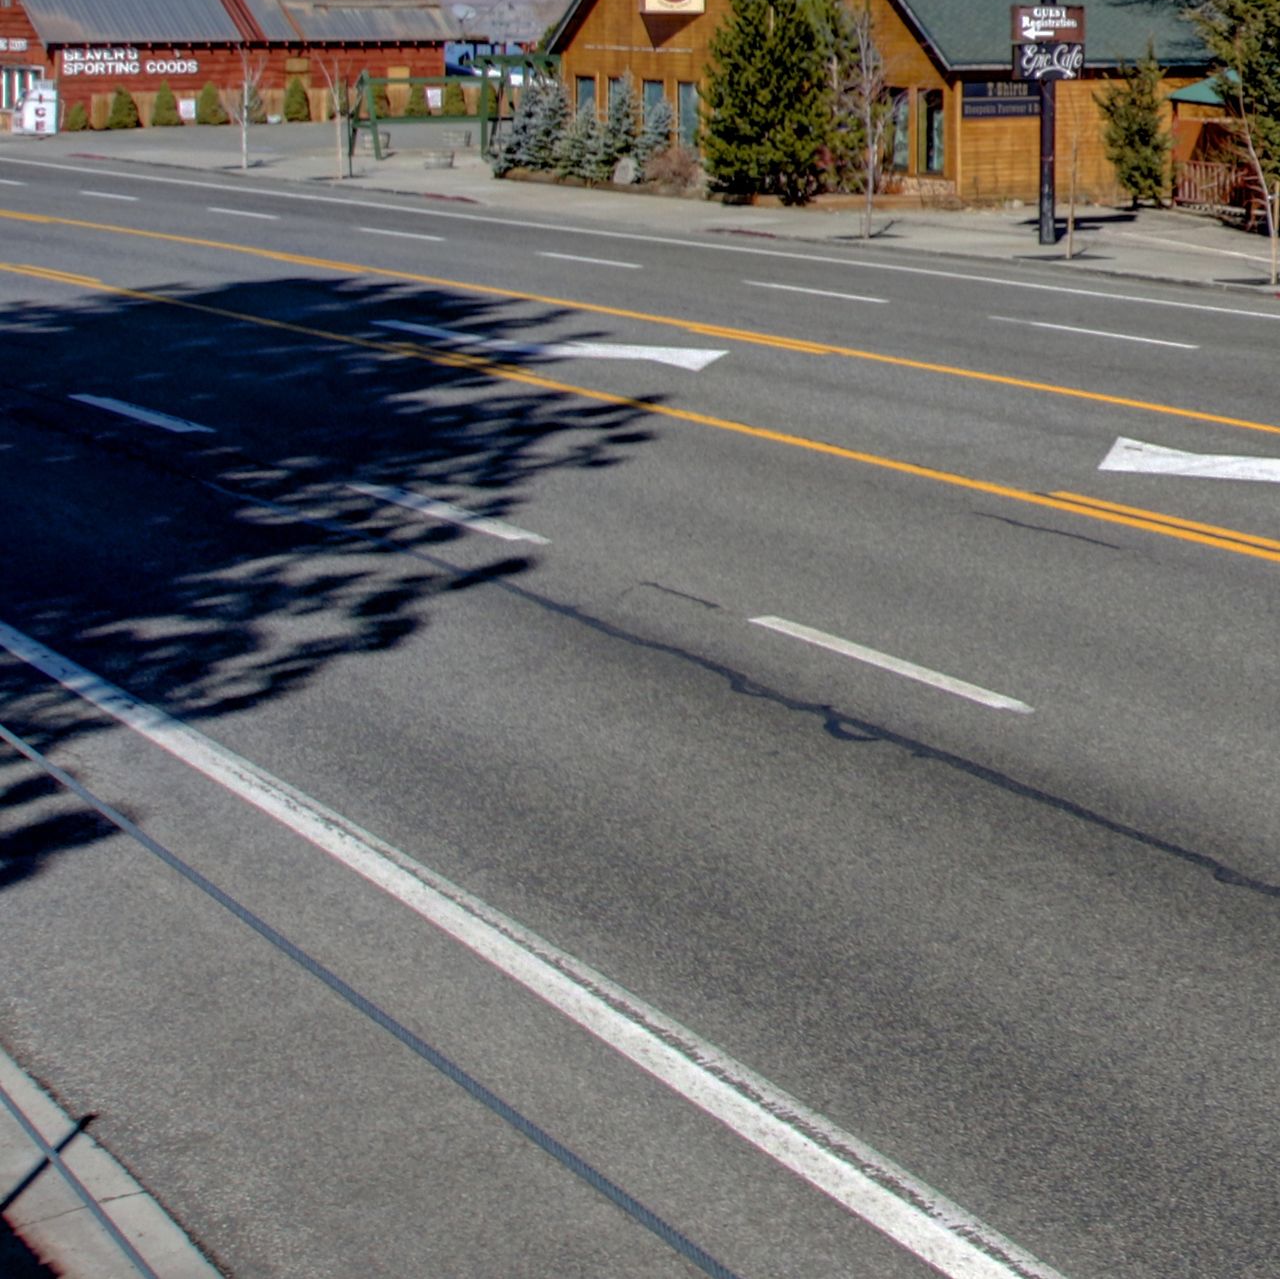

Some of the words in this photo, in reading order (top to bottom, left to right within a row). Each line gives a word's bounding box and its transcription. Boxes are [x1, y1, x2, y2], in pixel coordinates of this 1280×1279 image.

[63, 61, 140, 75] SPORTING
[146, 60, 199, 74] GOODS
[1021, 44, 1051, 76] Epic
[1053, 44, 1083, 73] Cafe
